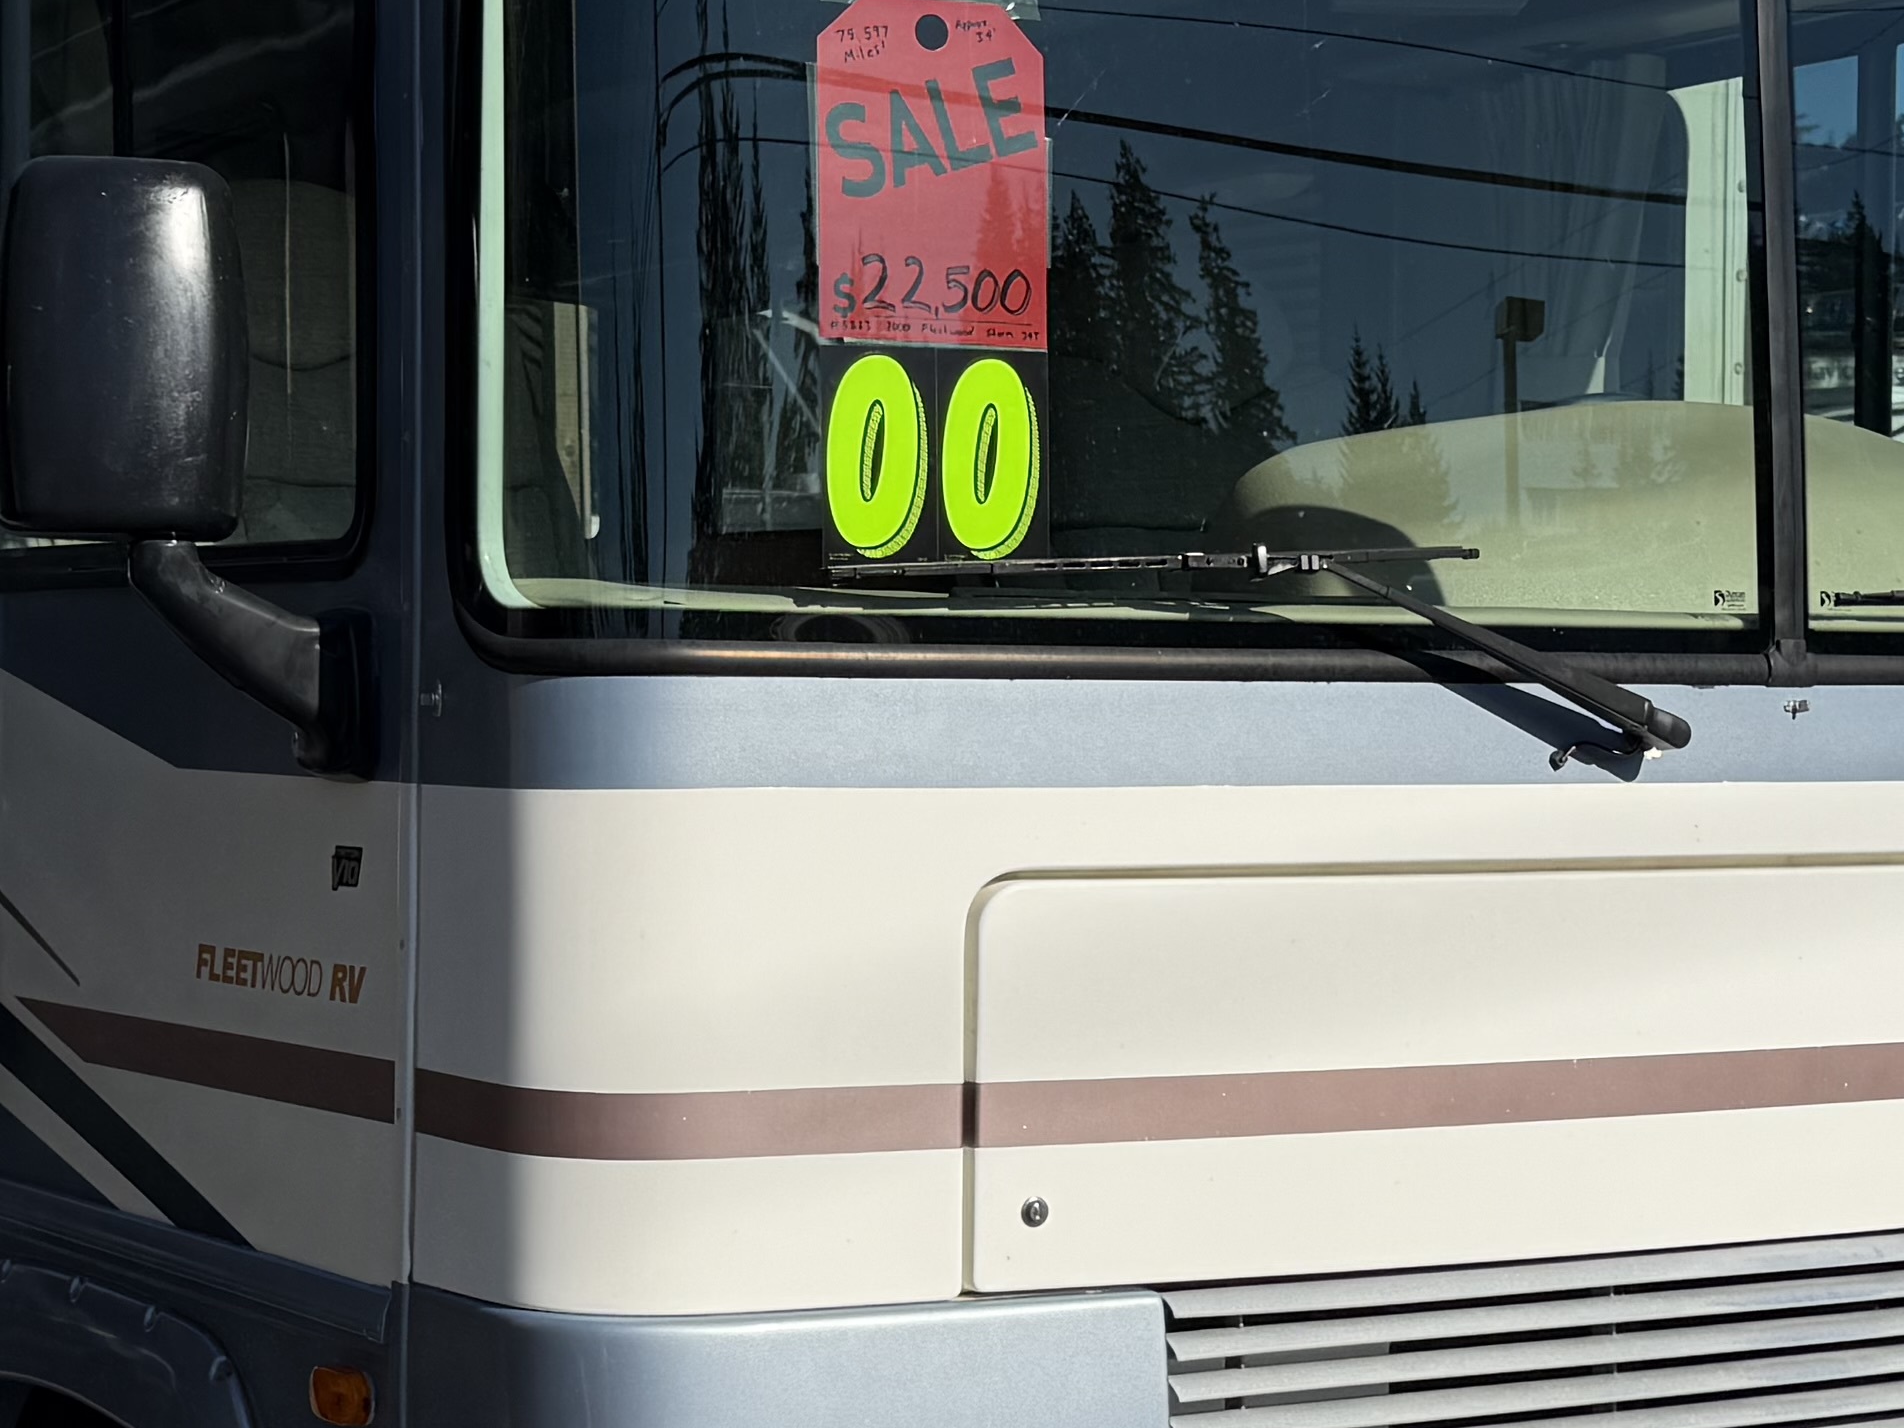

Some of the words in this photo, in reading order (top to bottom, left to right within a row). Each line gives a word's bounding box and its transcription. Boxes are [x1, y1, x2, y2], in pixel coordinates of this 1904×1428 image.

[825, 57, 1038, 198] SALE
[833, 253, 1032, 319] $22,500
[196, 943, 323, 998] FLEETWOOD
[329, 963, 368, 1005] RV
